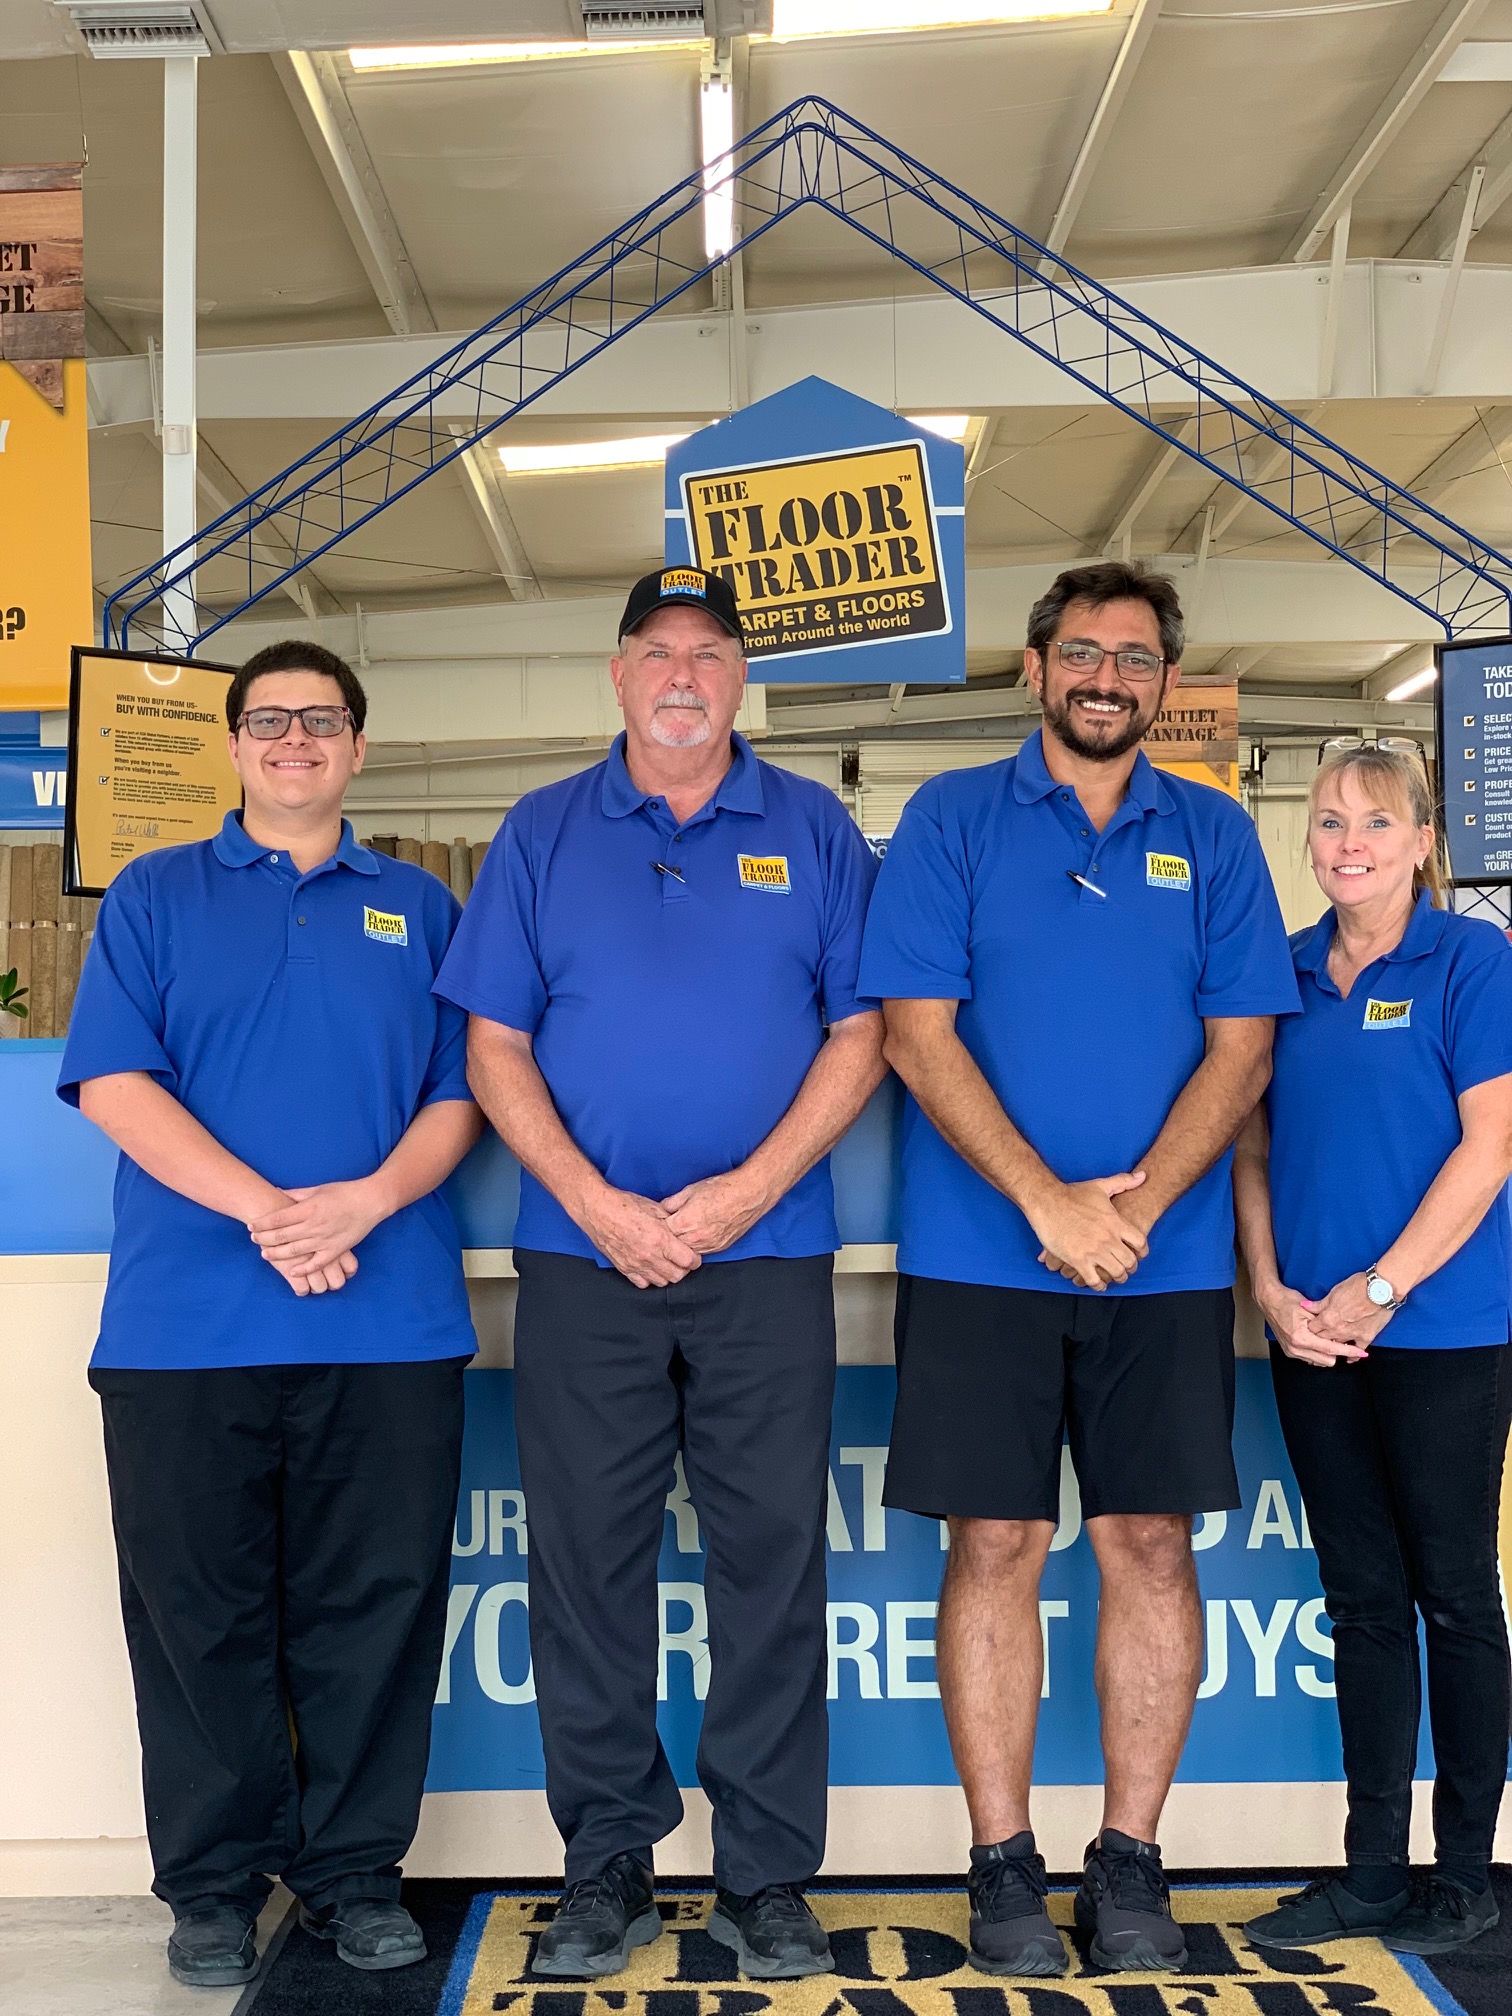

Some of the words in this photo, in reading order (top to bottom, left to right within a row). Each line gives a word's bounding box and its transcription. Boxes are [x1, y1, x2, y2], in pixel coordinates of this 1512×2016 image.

[698, 481, 749, 506] THE
[704, 483, 912, 560] FLOOR
[711, 535, 925, 603] TRADER
[664, 573, 703, 584] FLOOR
[662, 580, 703, 590] TRADER
[662, 587, 704, 597] OUTLET
[739, 606, 806, 632] ARPET
[814, 603, 831, 622] &
[838, 589, 925, 616] FLOORS
[781, 622, 834, 643] Around
[838, 621, 863, 635] the
[867, 613, 910, 632] World
[116, 694, 135, 702] WHEN
[137, 696, 150, 704] YOU
[152, 698, 164, 706] BUY
[166, 699, 185, 708] FROM
[116, 704, 135, 715] BUY
[137, 705, 160, 718] WITH
[162, 708, 219, 724] CONFIDENCE.
[1156, 709, 1218, 723] OUTLET
[1484, 713, 1512, 724] SELEC
[1484, 724, 1509, 733] Explore
[1484, 732, 1511, 741] in-stock
[1484, 746, 1511, 757] PRICE
[1484, 758, 1496, 766] Get
[1484, 766, 1499, 774] Low
[1484, 790, 1510, 799] Consult
[1484, 823, 1504, 832] Count
[1484, 830, 1511, 840] product
[742, 863, 783, 875] FLOOR
[1151, 857, 1186, 871] FLOOR
[1484, 861, 1510, 872] YOUR
[742, 872, 787, 884] TRADER
[1150, 866, 1188, 879] TRADER
[1151, 878, 1187, 888] OUTLET
[368, 913, 402, 927] FLOOR
[367, 921, 404, 934] TRADER
[368, 931, 404, 943] OUTLET
[452, 1489, 528, 1556] UR
[435, 1582, 712, 1704] YOR
